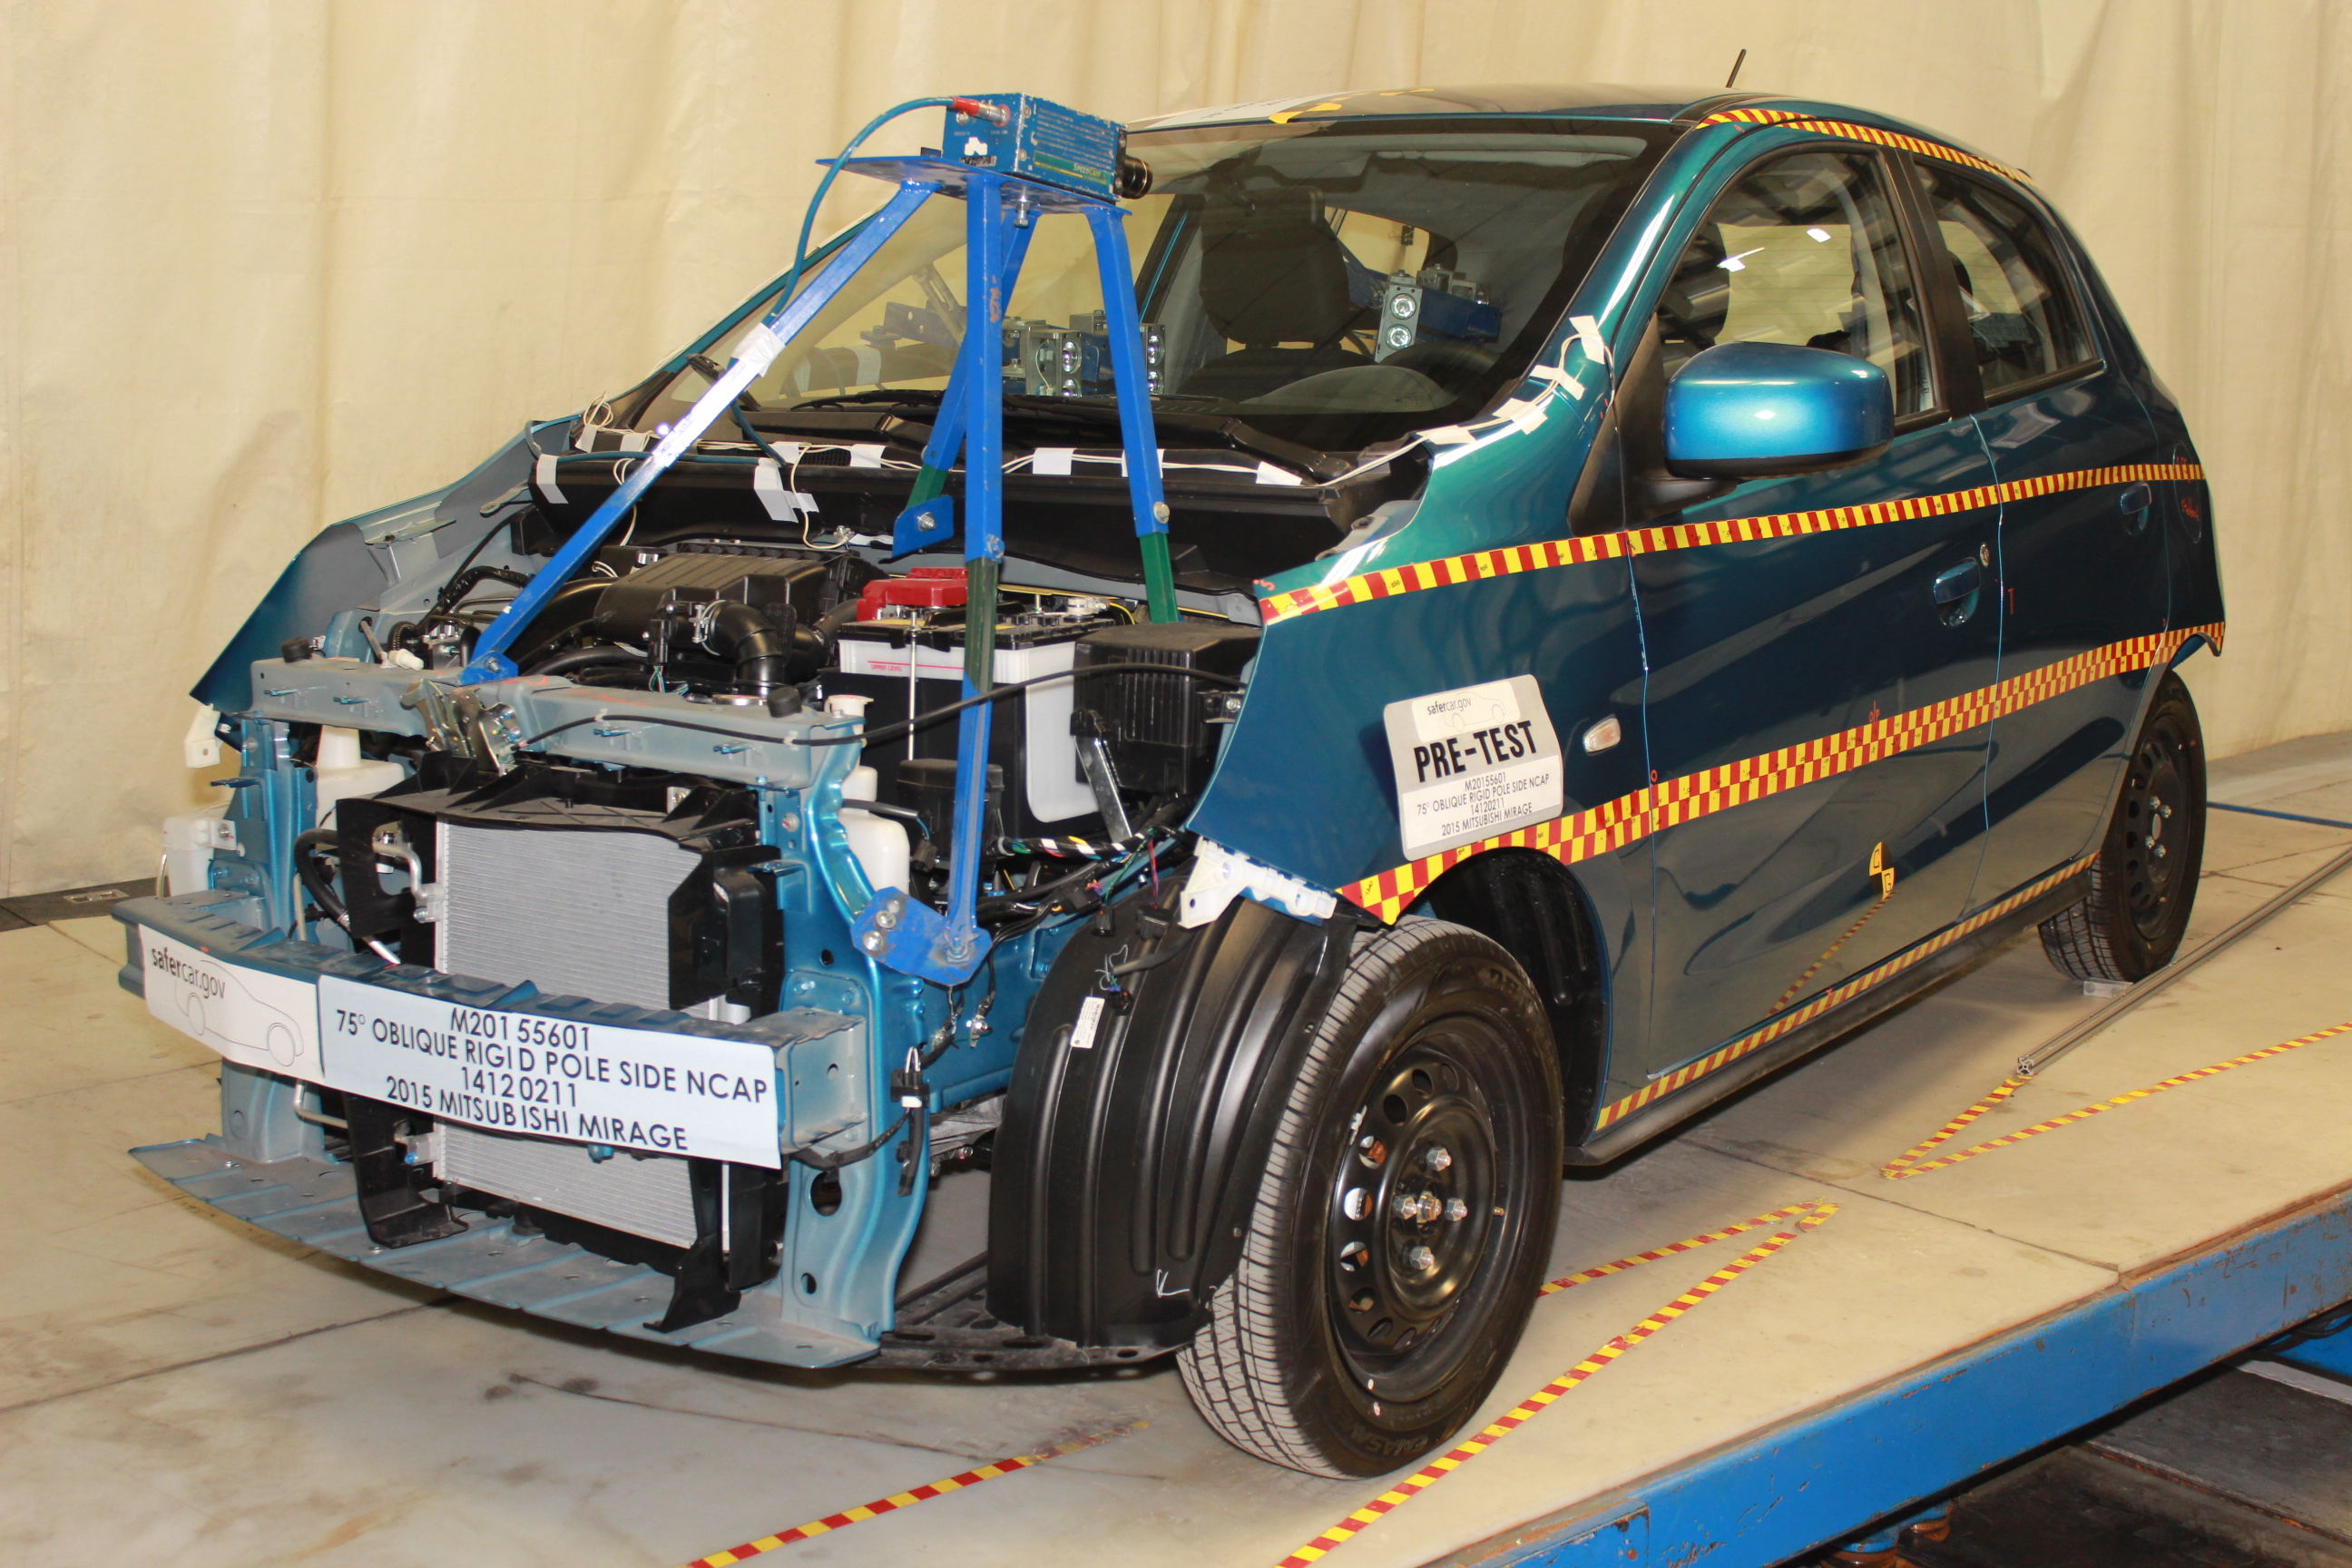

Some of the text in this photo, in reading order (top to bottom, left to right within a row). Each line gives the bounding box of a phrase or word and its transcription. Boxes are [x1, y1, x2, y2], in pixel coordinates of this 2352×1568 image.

[1426, 696, 1472, 716] safercar.gov
[1413, 720, 1537, 783] PRE-TEST
[1433, 793, 1467, 812] OBLIQUE
[1469, 789, 1490, 803] RIGID
[1492, 783, 1511, 799] POLE
[1512, 778, 1527, 793] SIDE
[1529, 773, 1550, 788] NCAP
[1465, 772, 1506, 791] M20155601
[1442, 802, 1533, 837] 2015 MITSUBISHI MIRAGE
[1470, 798, 1504, 816] 14120211
[152, 946, 226, 999] safercar.gov
[372, 1018, 457, 1061] OBLIQUE
[466, 1039, 535, 1073] RIGID
[546, 1051, 610, 1083] POLE
[620, 1061, 677, 1093] SIDE
[687, 1070, 768, 1103] NCAP
[387, 1075, 688, 1151] 2015 MITSUBISHI MIRAGE
